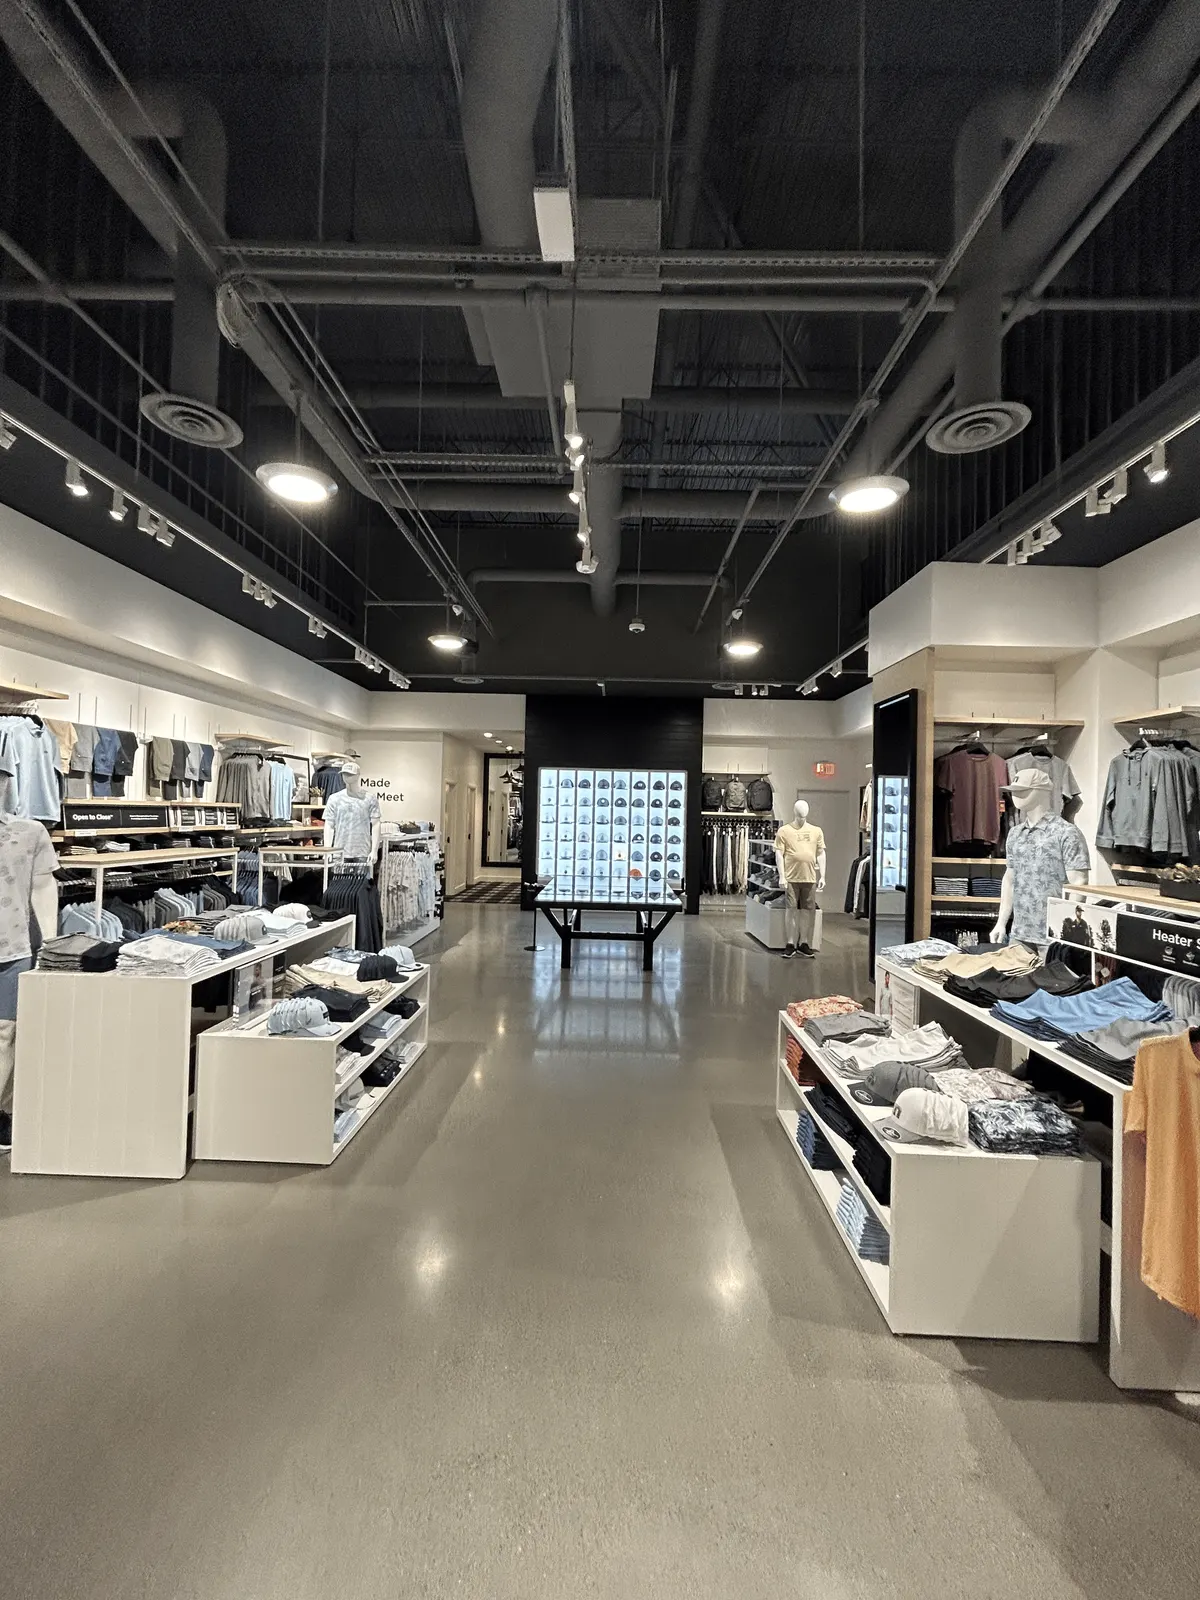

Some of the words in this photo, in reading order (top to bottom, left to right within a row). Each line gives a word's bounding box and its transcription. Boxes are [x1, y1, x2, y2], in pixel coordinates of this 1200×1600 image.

[360, 778, 390, 787] Made
[376, 792, 404, 801] Meet
[72, 814, 88, 822] Open
[1152, 928, 1193, 947] Heater
